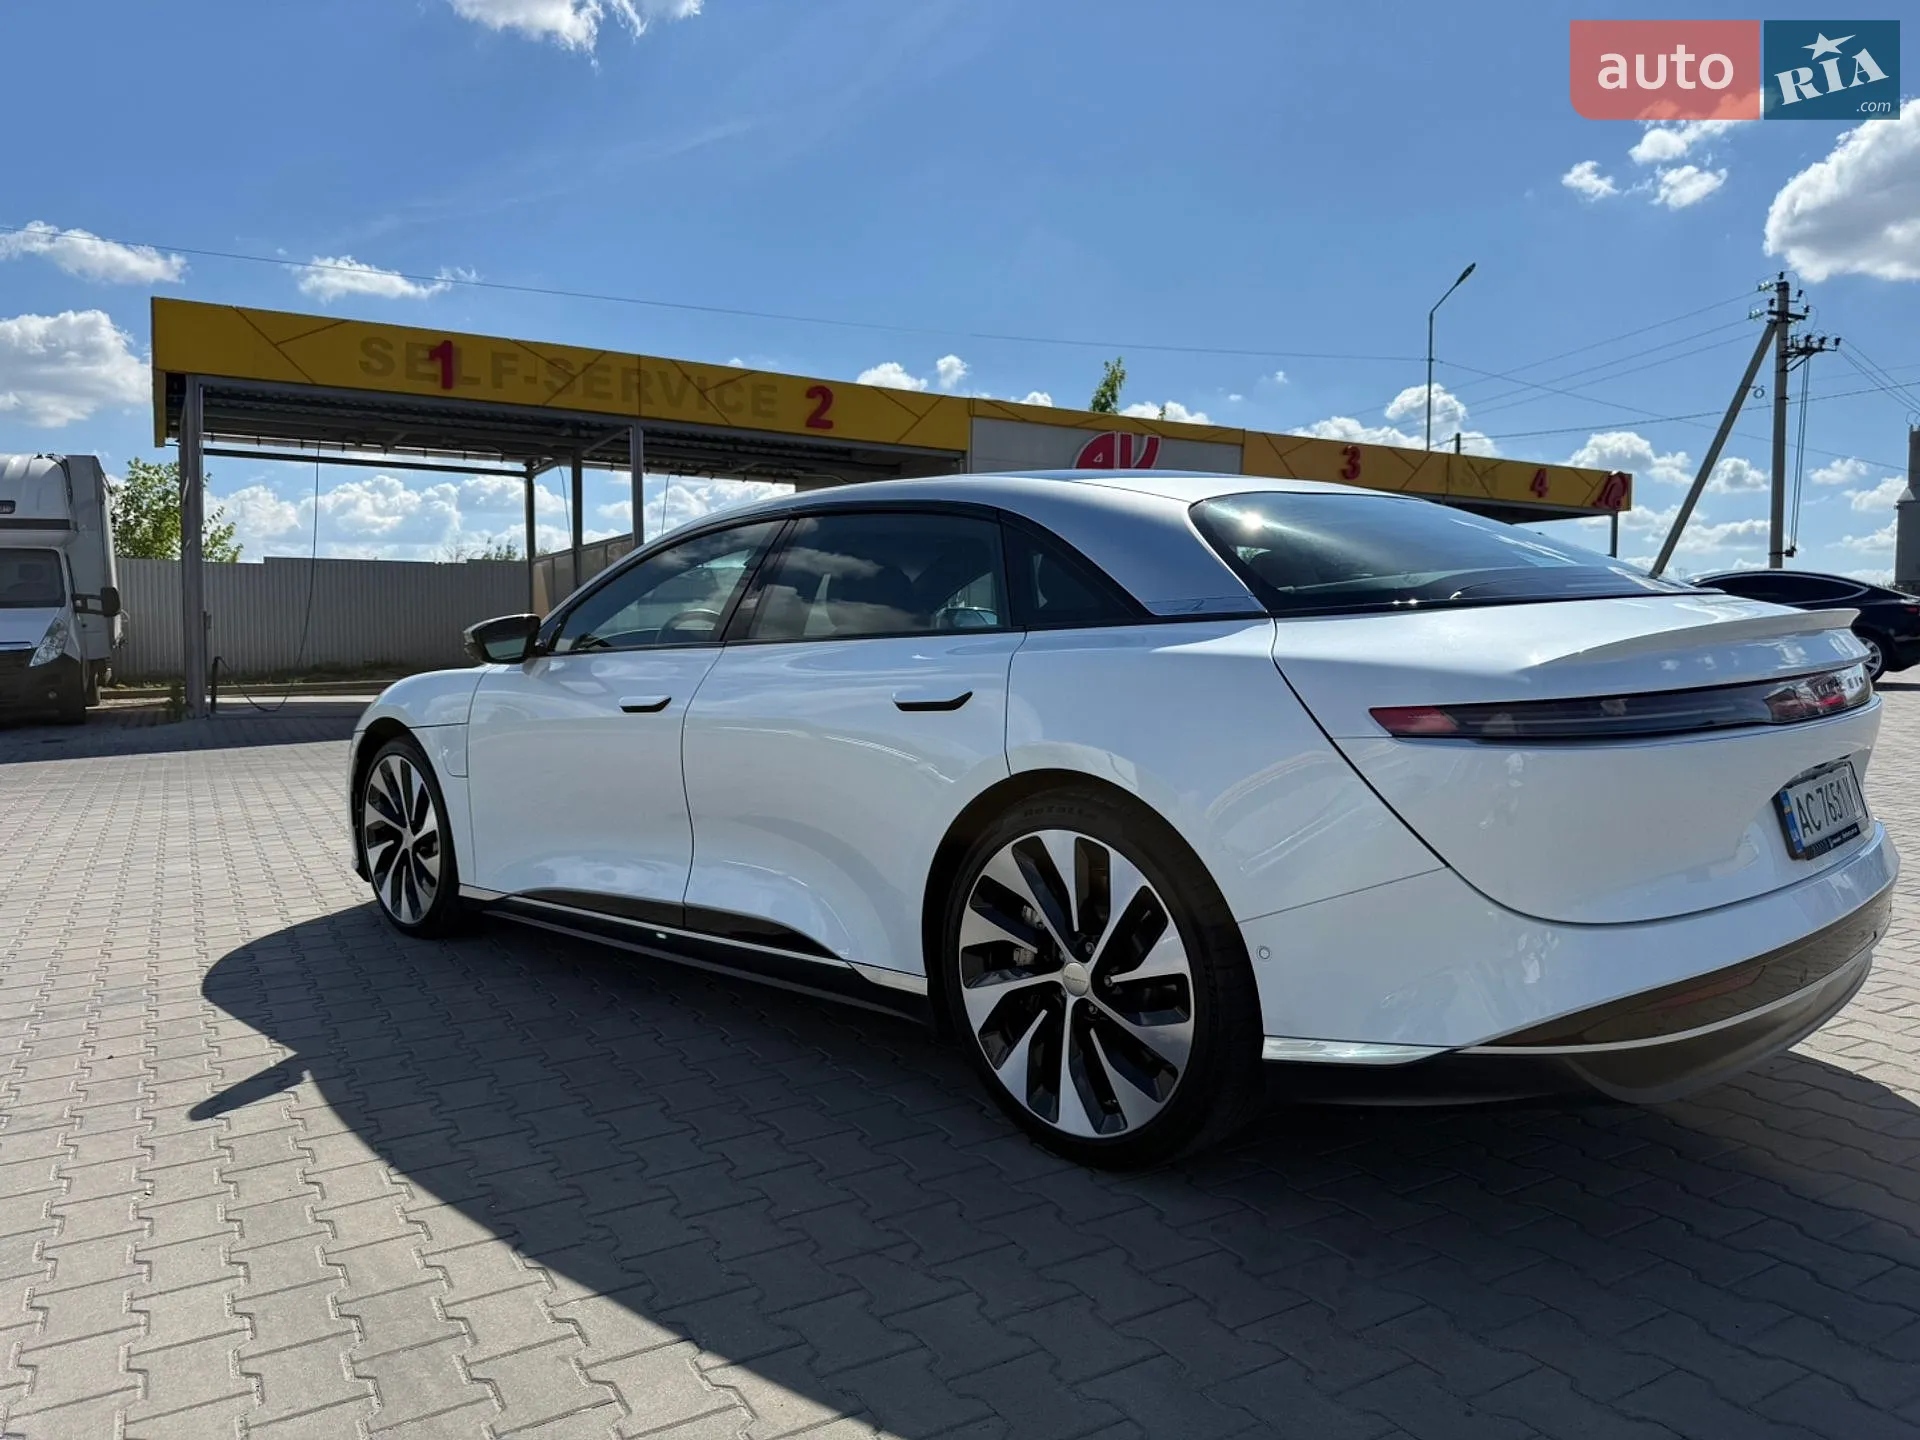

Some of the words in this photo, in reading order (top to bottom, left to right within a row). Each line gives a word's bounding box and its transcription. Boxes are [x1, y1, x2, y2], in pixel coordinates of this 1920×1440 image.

[428, 340, 453, 390] 1
[805, 385, 834, 430] 2
[1341, 445, 1361, 480] 3
[1530, 468, 1549, 498] 4
